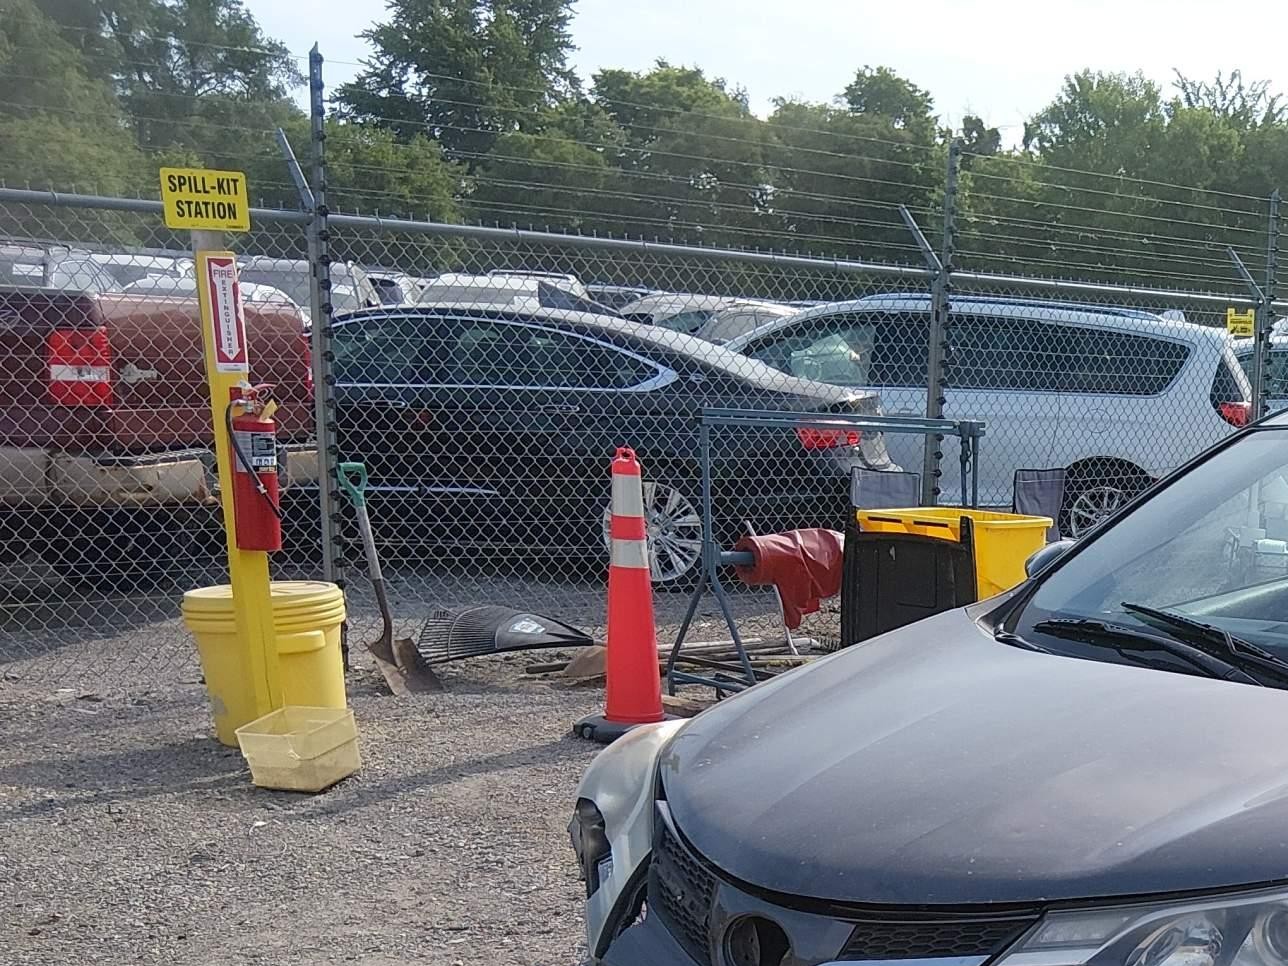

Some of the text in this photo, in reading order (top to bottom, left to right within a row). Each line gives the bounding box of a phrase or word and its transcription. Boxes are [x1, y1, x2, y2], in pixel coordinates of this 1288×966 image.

[167, 174, 239, 195] SPILL-KIT
[176, 199, 237, 220] STATION
[213, 268, 233, 279] FIRE
[220, 279, 235, 356] EXTINGUISHER
